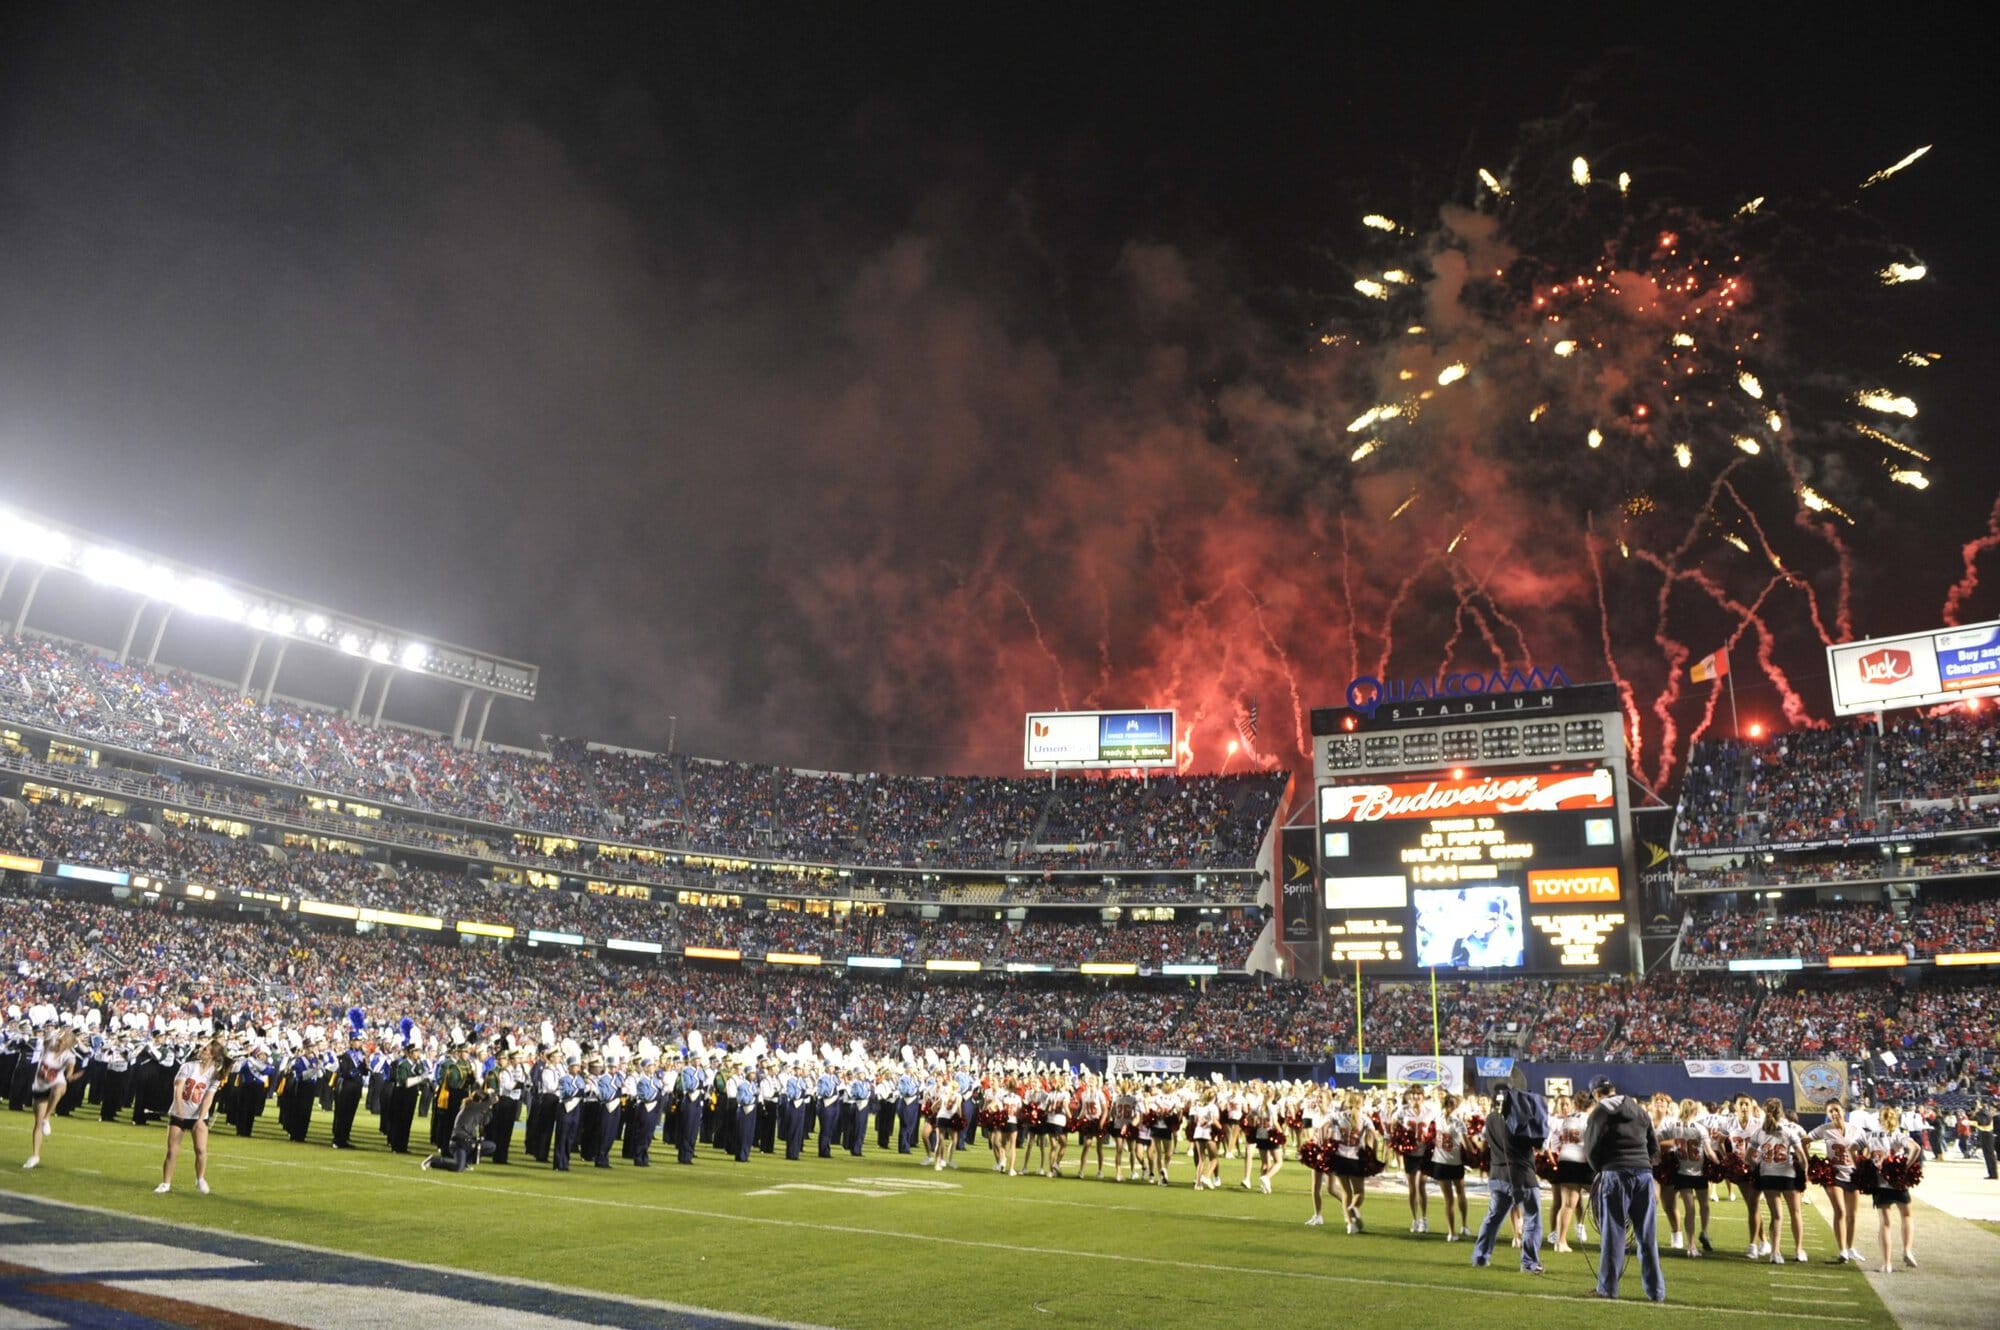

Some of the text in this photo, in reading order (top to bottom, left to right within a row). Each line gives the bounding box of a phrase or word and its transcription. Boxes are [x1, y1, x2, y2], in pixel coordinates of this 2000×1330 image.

[1957, 650, 1980, 662] Buy
[1862, 652, 1912, 682] Jack
[1945, 661, 1997, 676] Chargers
[1346, 664, 1572, 719] QUALCOMM
[1392, 695, 1553, 719] STADIUM
[1283, 883, 1314, 897] Sprint
[1532, 876, 1616, 896] TOYOTA
[1758, 1063, 1781, 1082] N
[182, 1078, 207, 1104] 36
